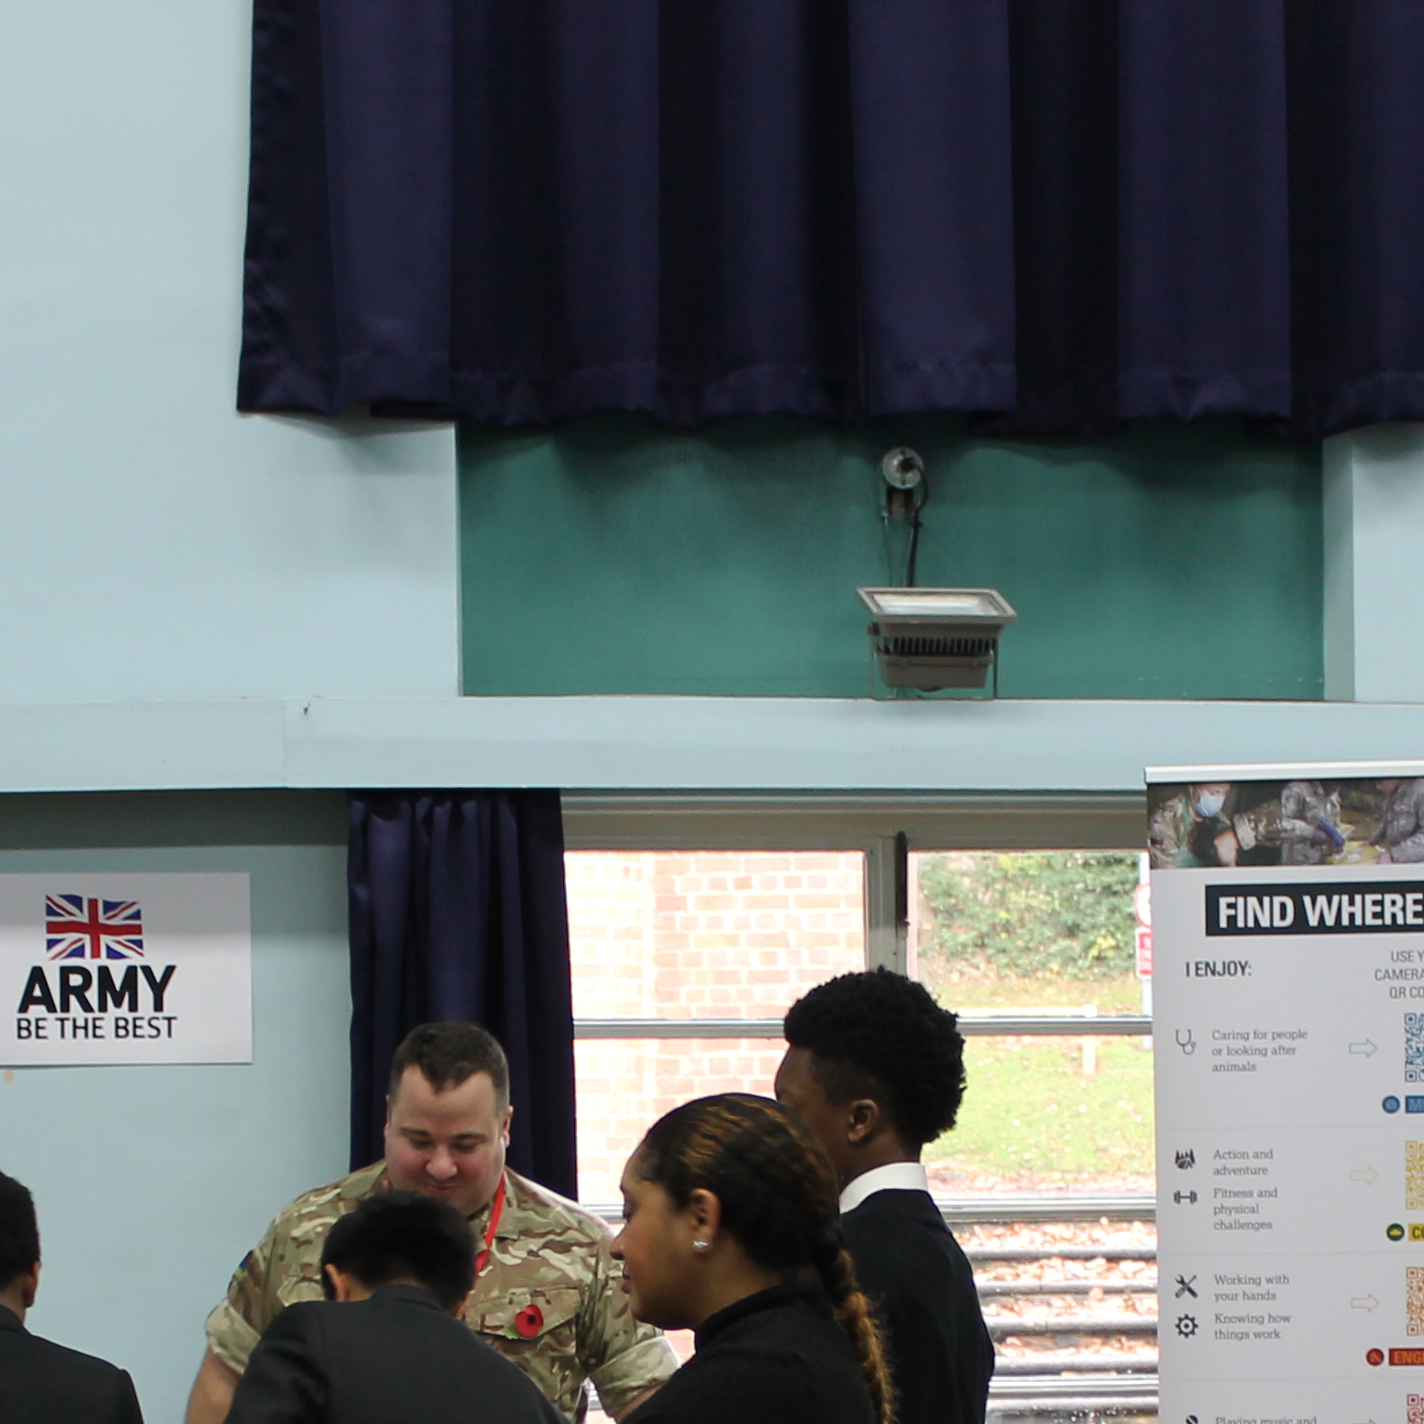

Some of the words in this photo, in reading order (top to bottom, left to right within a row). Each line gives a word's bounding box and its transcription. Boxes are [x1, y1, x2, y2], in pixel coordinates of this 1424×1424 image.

[1219, 895, 1293, 927] FIND
[1303, 893, 1423, 926] WHERE
[1390, 949, 1414, 963] USE
[1186, 961, 1189, 977] I
[1194, 960, 1251, 977] ENJOY:
[18, 965, 176, 1017] ARMY
[1389, 986, 1406, 998] QR
[17, 1017, 47, 1039] BE
[55, 1017, 104, 1038] THE
[114, 1016, 176, 1038] BEST
[1211, 1028, 1250, 1043] Caring
[1253, 1028, 1268, 1040] for
[1271, 1027, 1307, 1042] people
[1211, 1048, 1222, 1056] or
[1226, 1044, 1267, 1059] looking
[1271, 1043, 1296, 1055] after
[1212, 1060, 1256, 1072] animals
[1213, 1147, 1249, 1159] Action
[1252, 1147, 1273, 1159] and
[1212, 1163, 1268, 1175] adventure
[1213, 1186, 1253, 1198] Fitness
[1256, 1186, 1277, 1198] and
[1213, 1202, 1259, 1217] physical
[1213, 1218, 1272, 1233] challenges
[1214, 1273, 1261, 1288] Working
[1264, 1272, 1289, 1284] with
[1214, 1293, 1238, 1304] your
[1242, 1288, 1276, 1300] hands
[1214, 1312, 1264, 1327] Knowing
[1267, 1310, 1291, 1322] how
[1214, 1328, 1249, 1343] things
[1252, 1327, 1280, 1339] work
